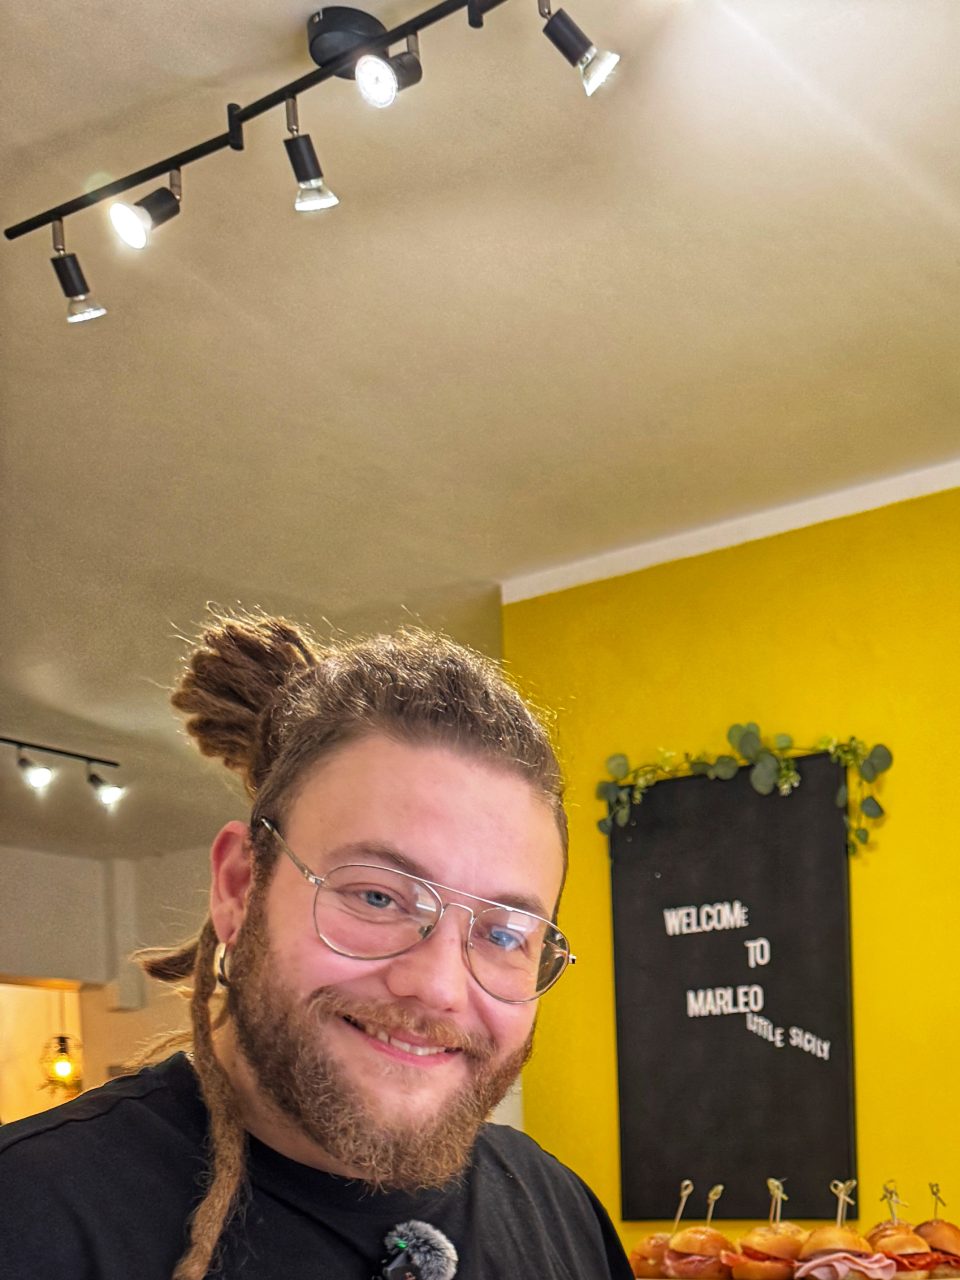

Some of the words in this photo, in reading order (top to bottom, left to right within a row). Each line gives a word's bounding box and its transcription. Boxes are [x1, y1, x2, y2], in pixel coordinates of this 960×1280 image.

[663, 900, 749, 936] WELCOME
[744, 937, 771, 968] TO
[686, 984, 764, 1017] MARLEO
[746, 1012, 785, 1048] LITTLE
[788, 1026, 831, 1060] SICILY
